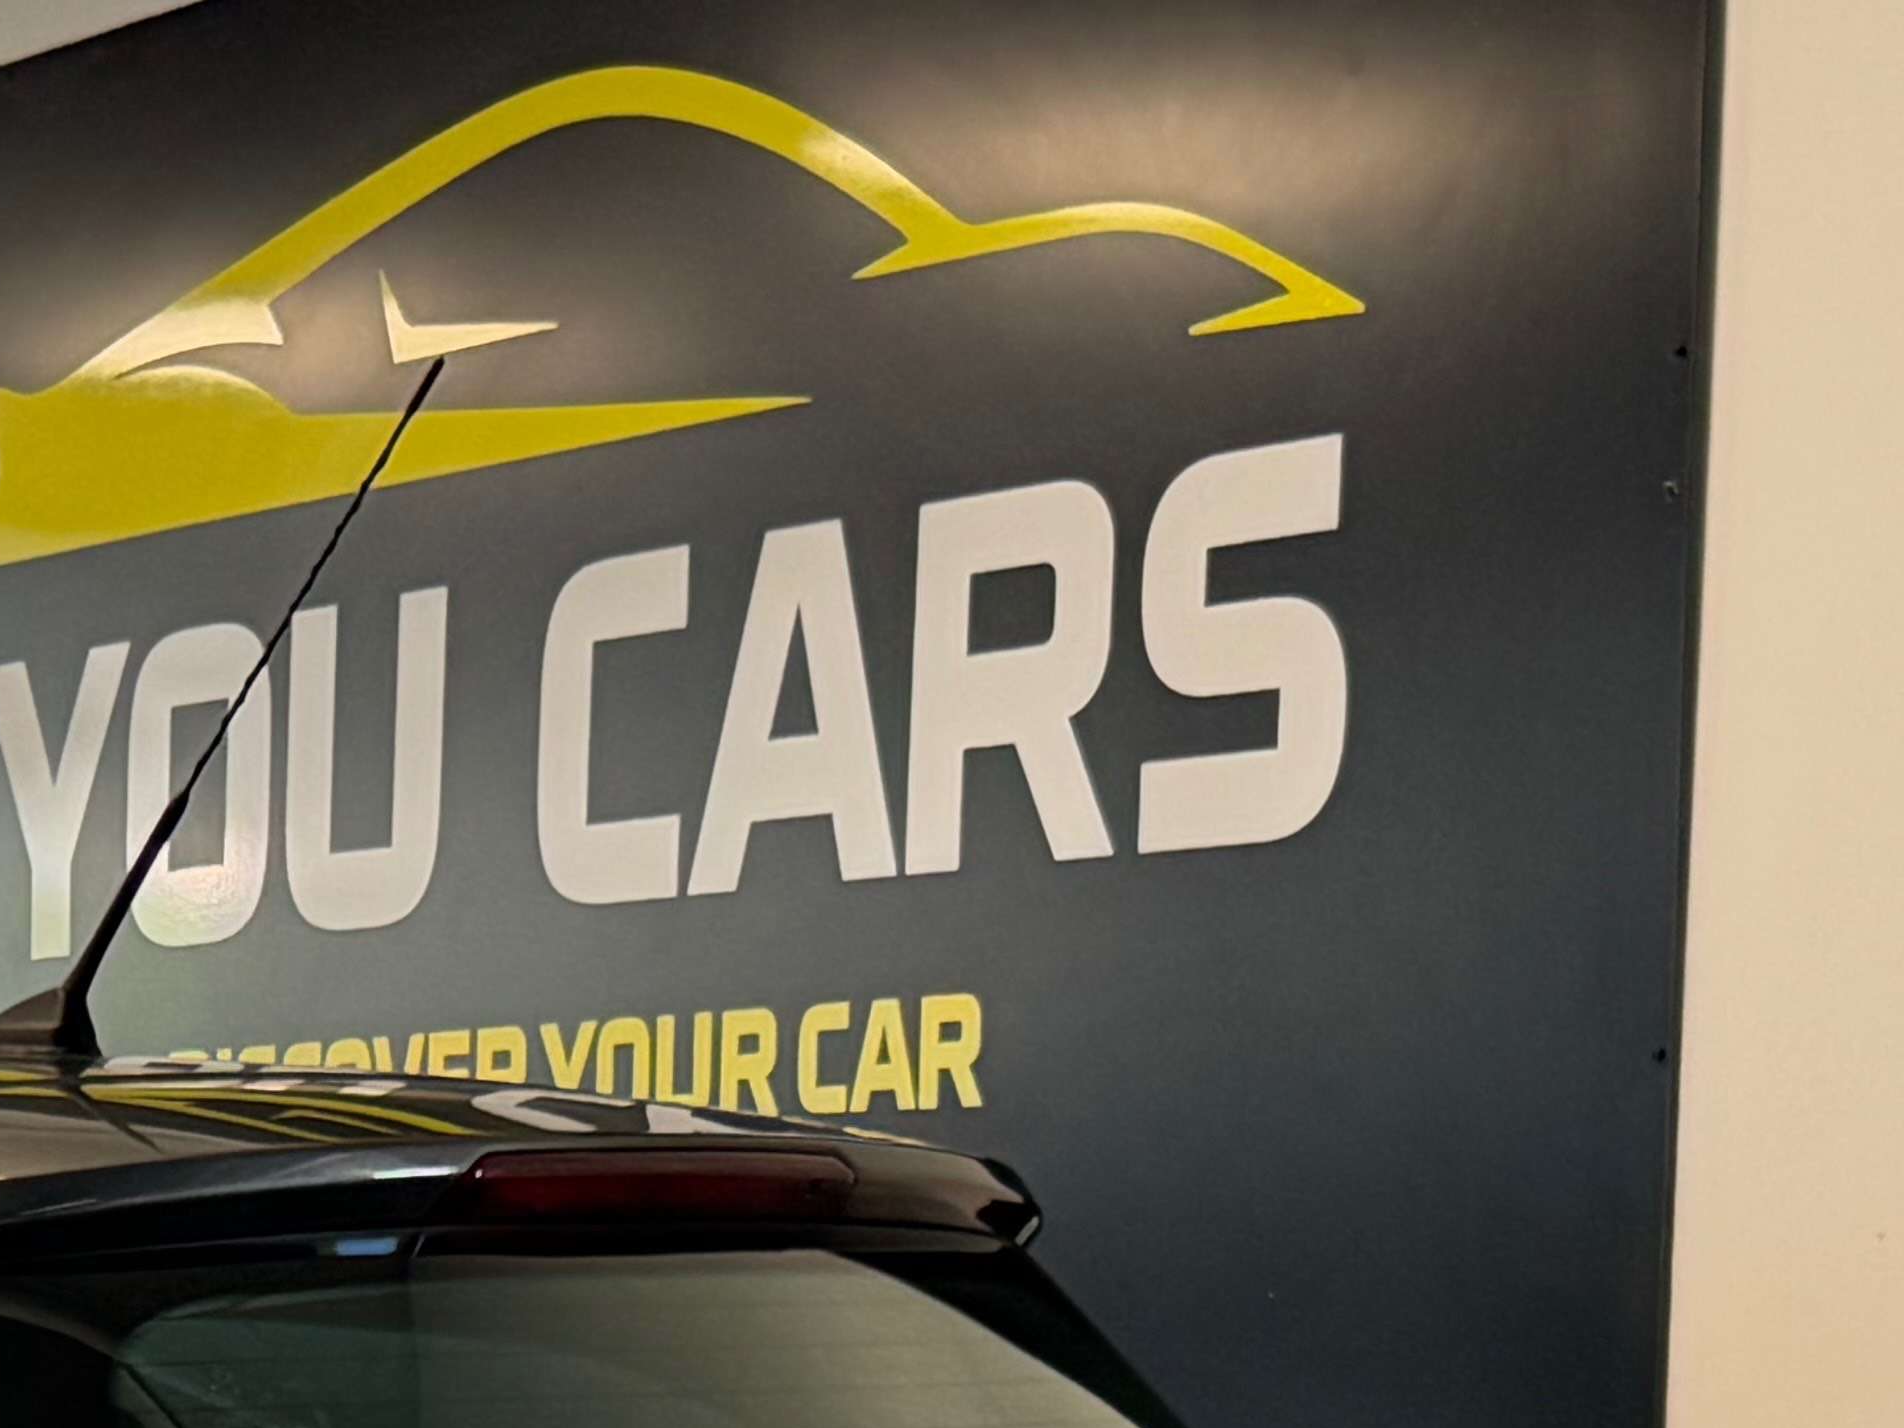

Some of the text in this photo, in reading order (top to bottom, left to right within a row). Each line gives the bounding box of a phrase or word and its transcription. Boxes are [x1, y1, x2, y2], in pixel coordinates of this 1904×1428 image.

[536, 433, 1348, 906] CARS
[540, 1007, 776, 1115] YOUR
[796, 992, 983, 1116] CAR
